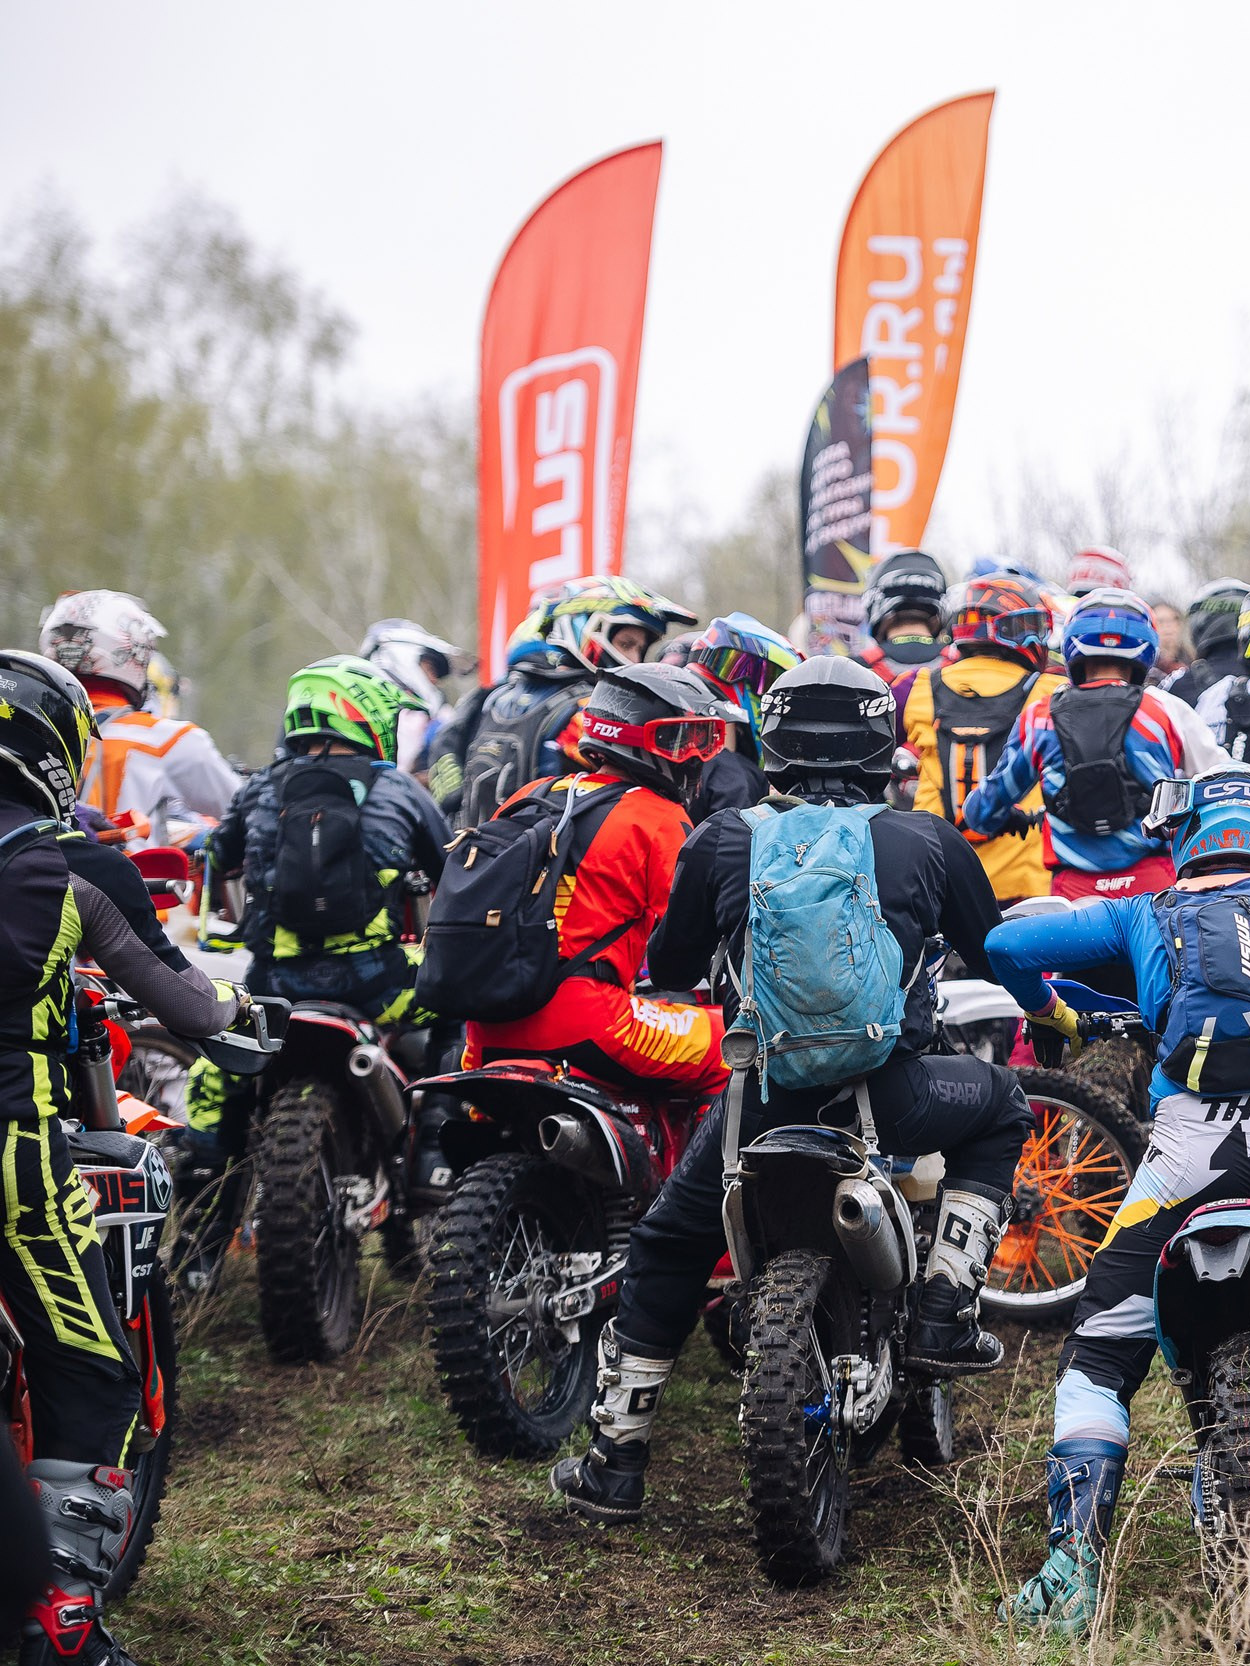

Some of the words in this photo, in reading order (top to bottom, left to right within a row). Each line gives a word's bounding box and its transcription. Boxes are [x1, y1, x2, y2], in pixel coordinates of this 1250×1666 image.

[529, 378, 589, 608] LUS
[592, 723, 624, 739] FOX
[1095, 876, 1136, 891] SHIFT
[942, 1211, 972, 1251] G
[131, 1262, 154, 1278] CST
